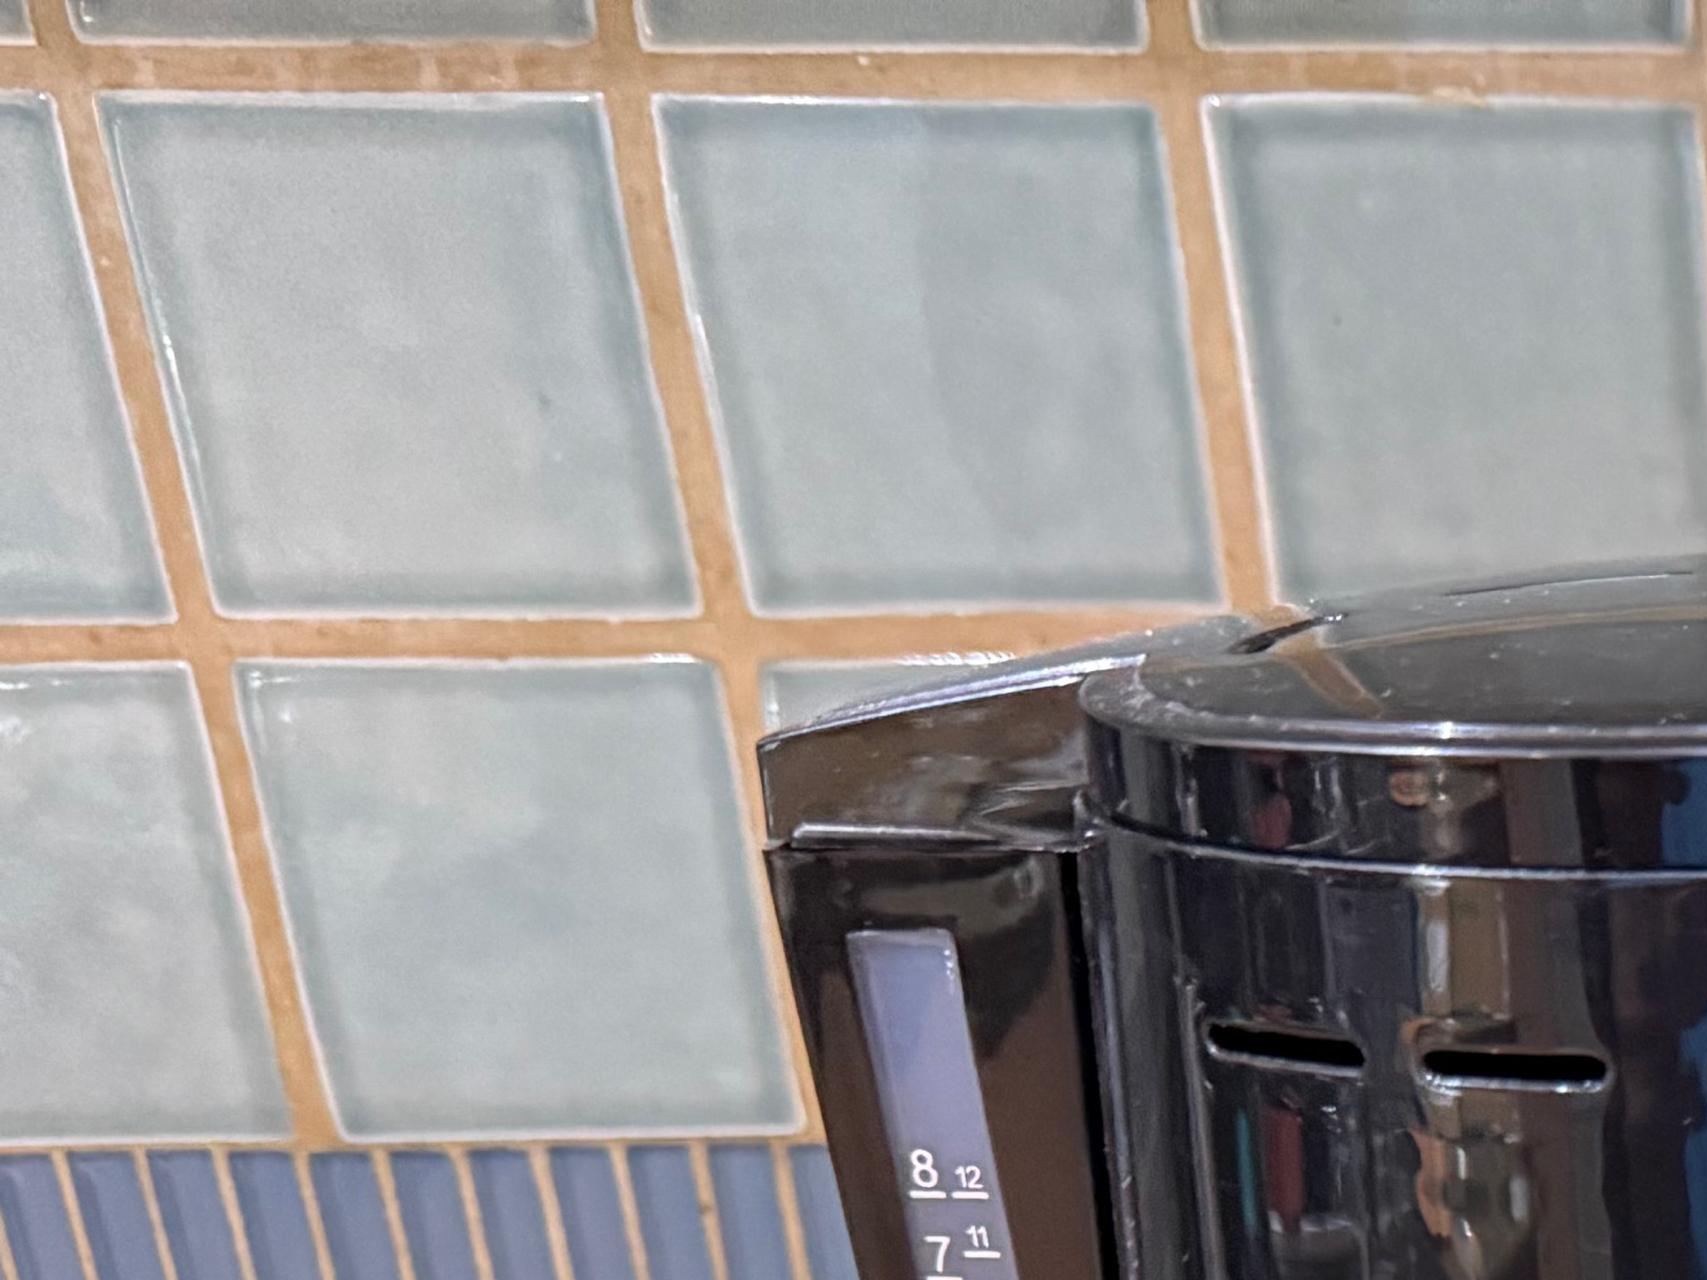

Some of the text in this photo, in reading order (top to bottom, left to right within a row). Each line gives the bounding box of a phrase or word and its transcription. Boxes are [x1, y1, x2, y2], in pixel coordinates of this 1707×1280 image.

[909, 1148, 984, 1189] 8 12
[923, 1225, 990, 1273] 7 11
